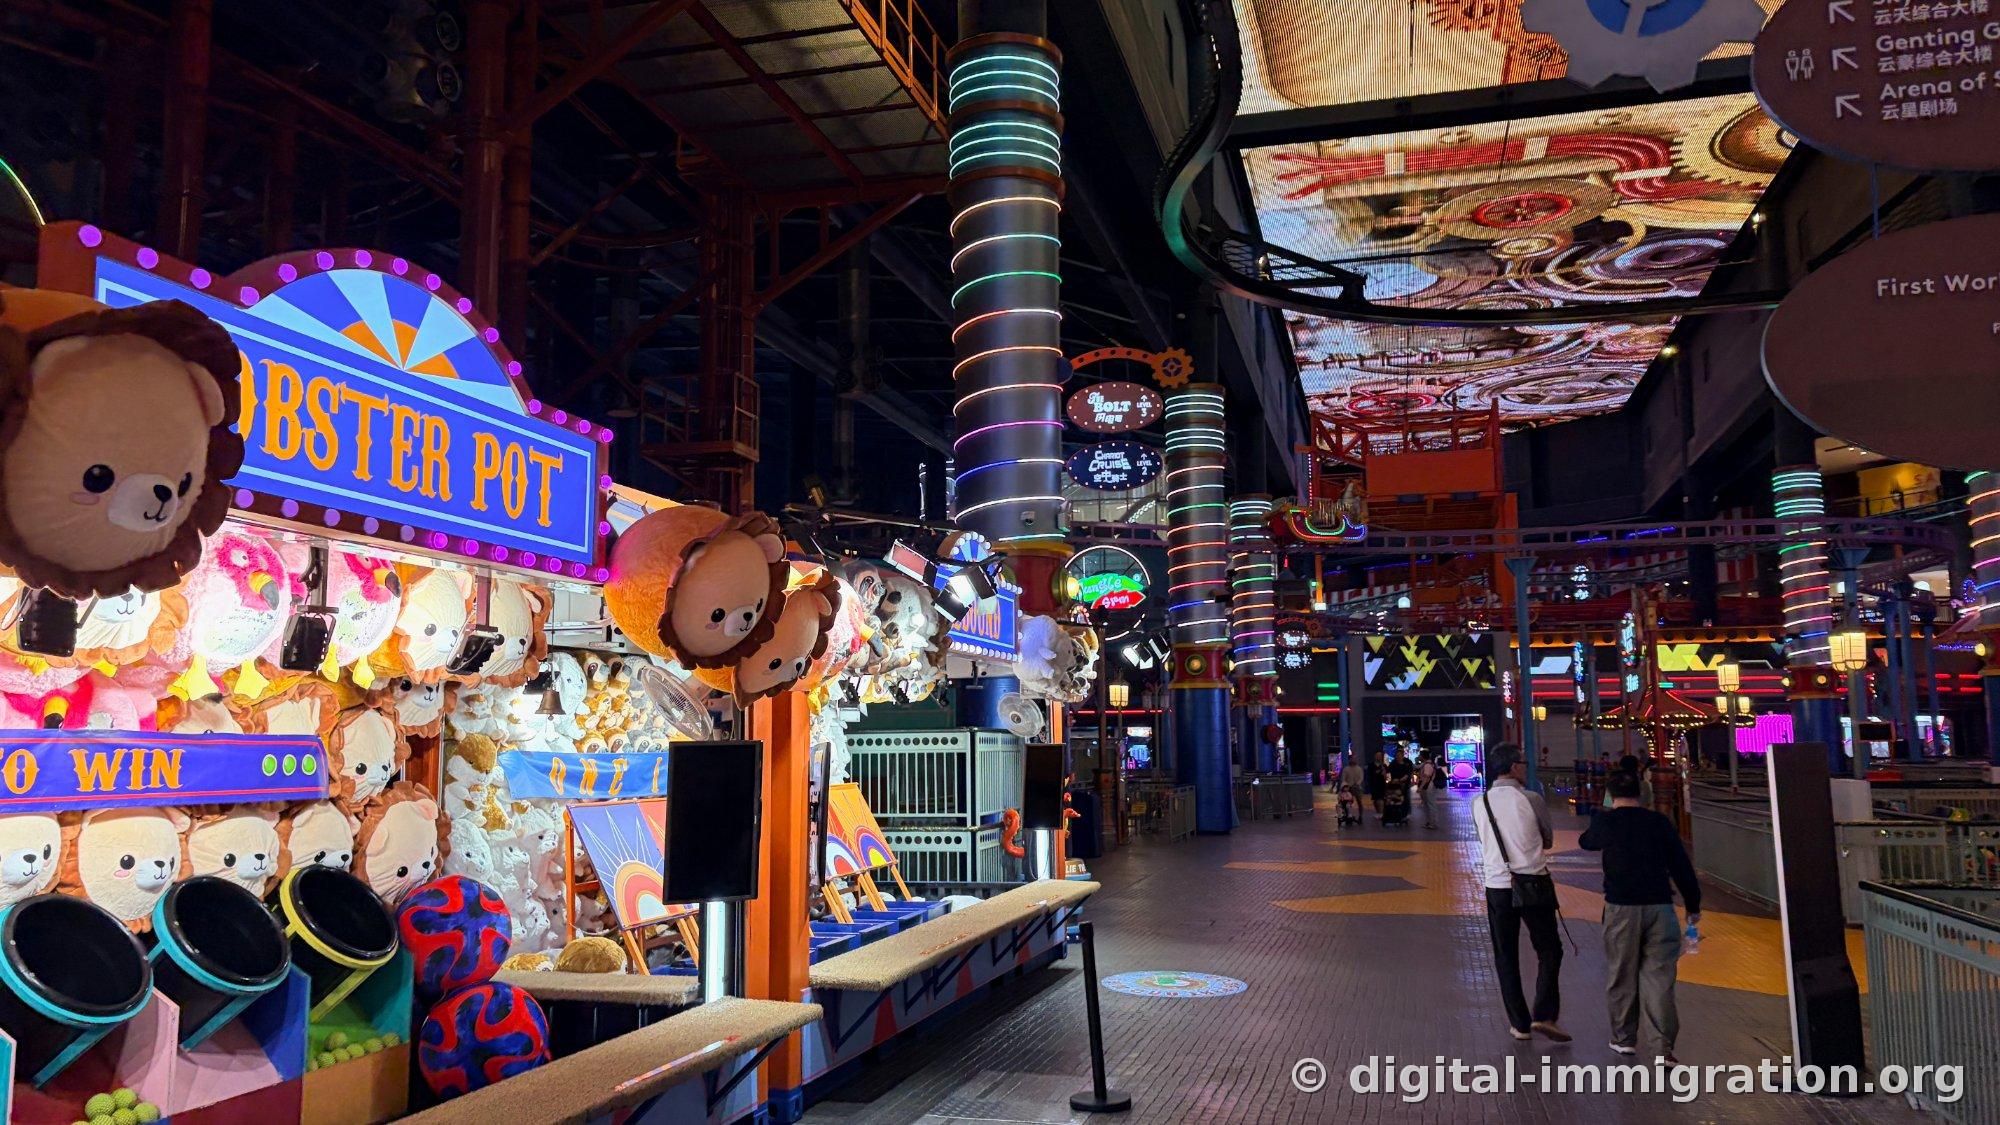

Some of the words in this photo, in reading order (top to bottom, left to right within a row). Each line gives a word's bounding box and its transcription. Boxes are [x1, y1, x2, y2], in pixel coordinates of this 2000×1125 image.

[1876, 28, 1975, 52] Genting
[1880, 80, 1952, 101] Arena
[1960, 72, 1987, 91] of
[1881, 98, 1958, 120] 云星剧场
[1876, 277, 1935, 297] First
[1944, 273, 2000, 292] Wor
[1093, 401, 1131, 412] BOLT
[1141, 408, 1148, 417] 3
[1088, 458, 1132, 472] CRUISE
[1141, 467, 1148, 476] 2
[470, 432, 563, 527] POT
[67, 748, 187, 792] WIN
